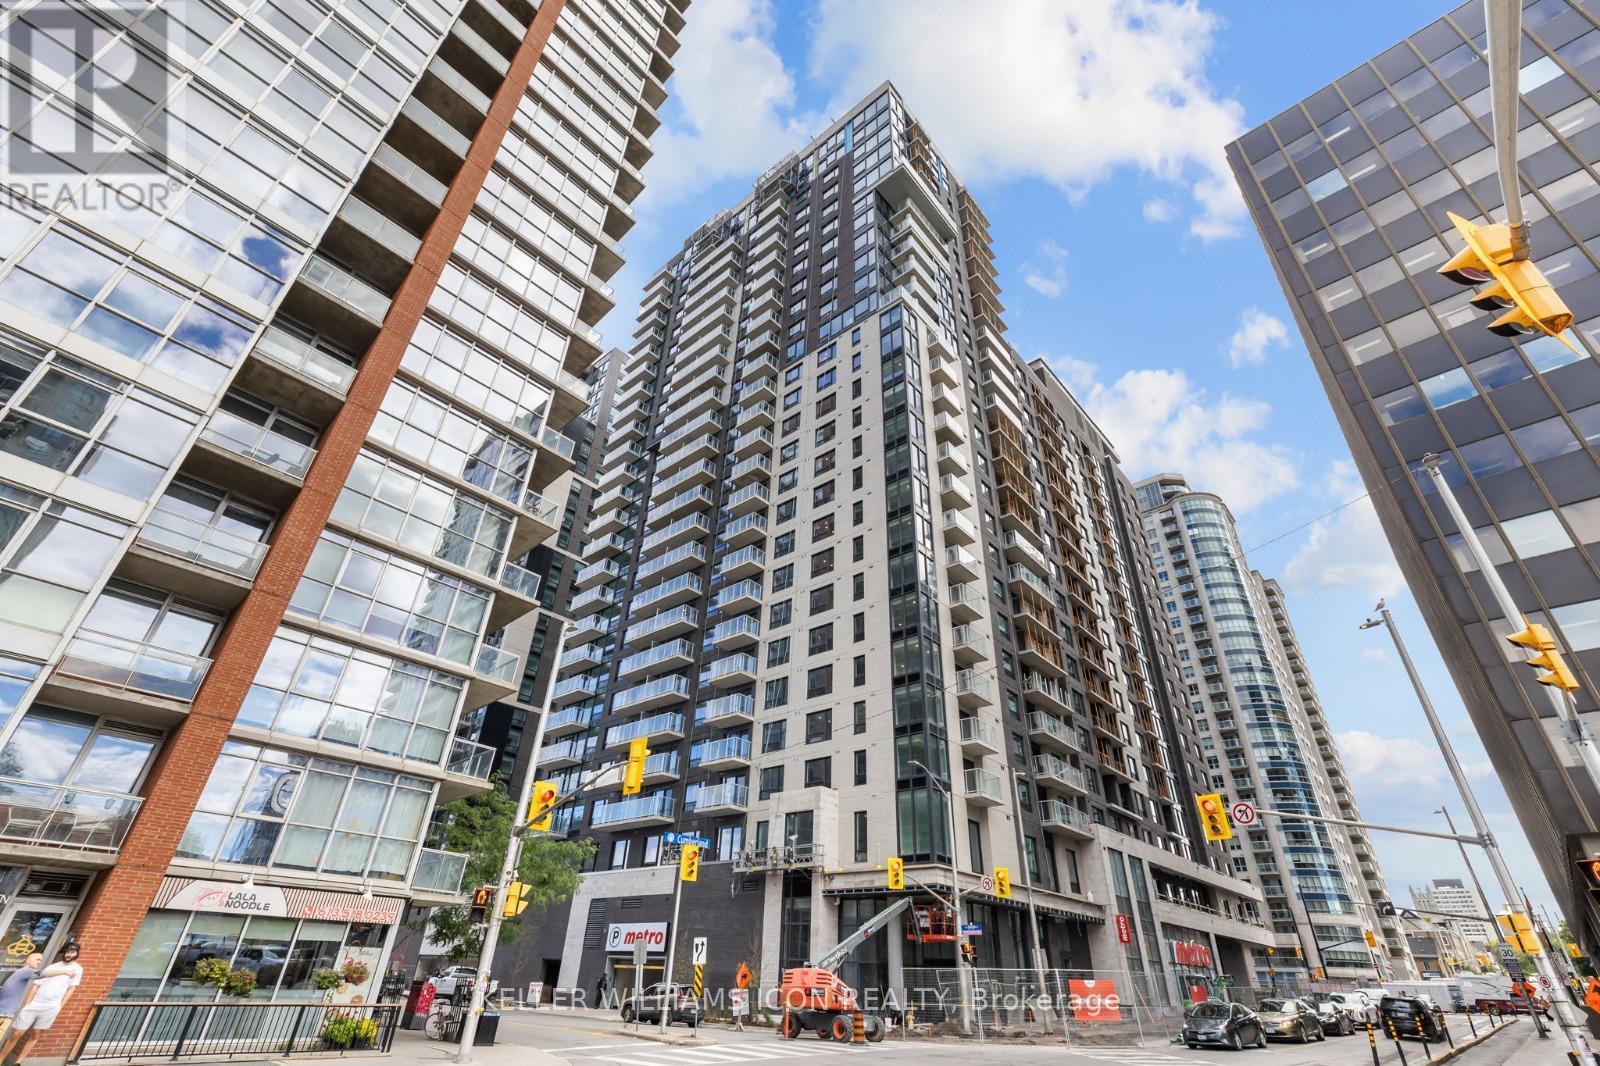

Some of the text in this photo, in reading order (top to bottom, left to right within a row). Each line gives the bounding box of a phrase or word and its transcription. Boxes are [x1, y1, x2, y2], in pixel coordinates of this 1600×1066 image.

[227, 892, 257, 901] LALA
[224, 900, 271, 911] NOODLE
[1119, 915, 1128, 942] metro
[623, 929, 663, 945] metro
[1501, 949, 1514, 958] 30
